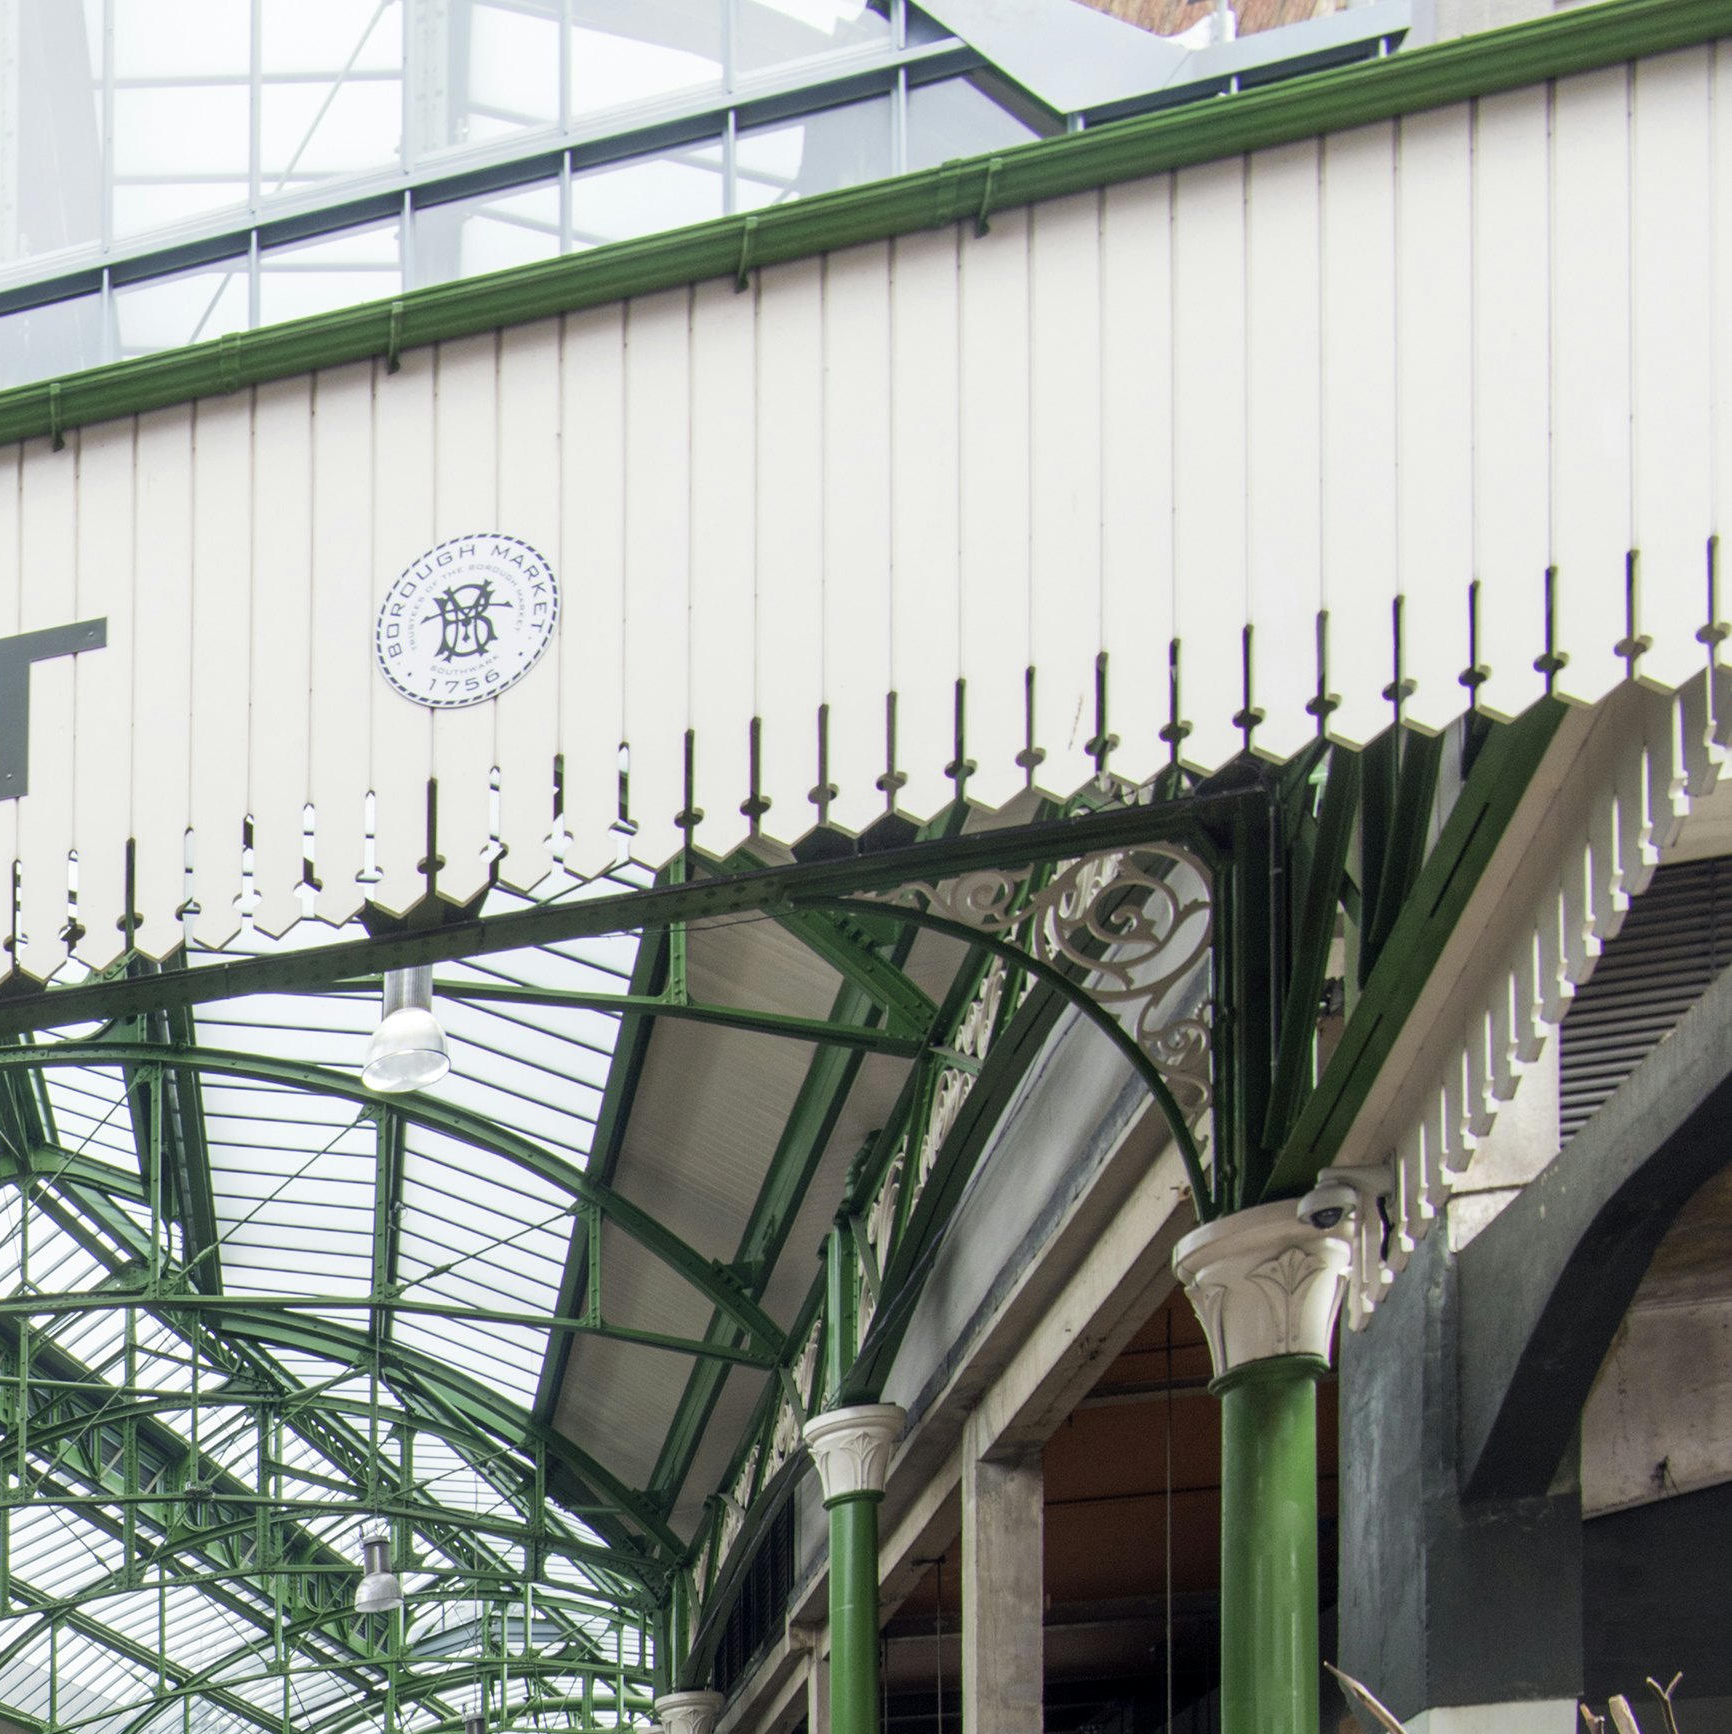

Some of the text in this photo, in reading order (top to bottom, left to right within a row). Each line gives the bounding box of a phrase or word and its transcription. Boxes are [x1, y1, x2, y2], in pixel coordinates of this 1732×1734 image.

[386, 544, 548, 658] BOROUGH MARKET
[430, 654, 500, 675] SOUTHWARK
[428, 669, 500, 694] 1756
